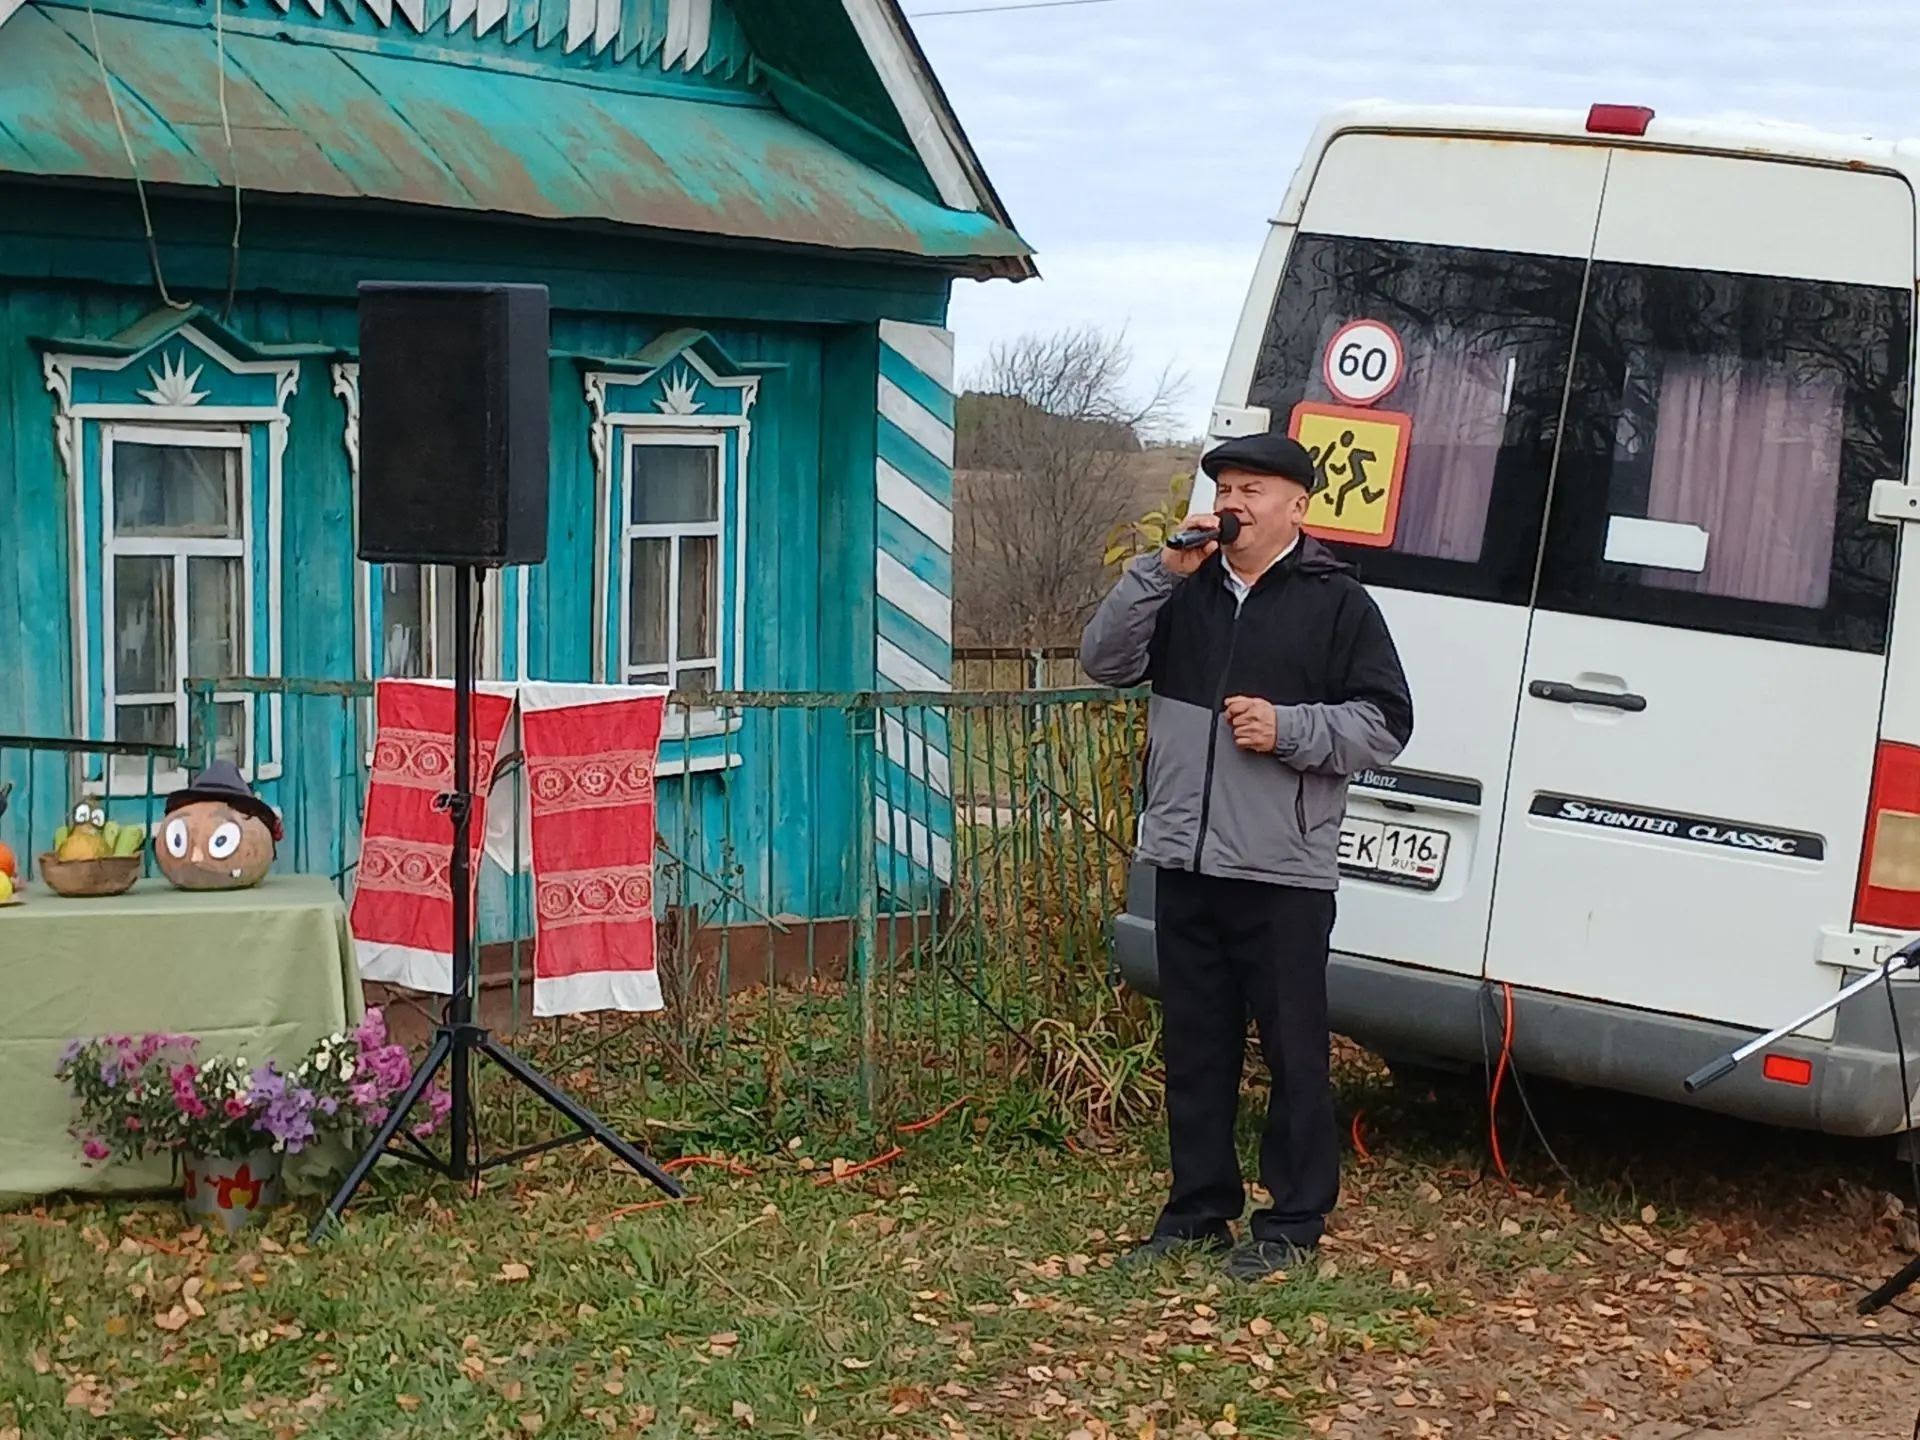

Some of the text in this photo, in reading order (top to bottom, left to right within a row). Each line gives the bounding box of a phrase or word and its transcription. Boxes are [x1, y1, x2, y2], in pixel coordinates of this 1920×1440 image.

[1339, 343, 1386, 381] 60
[1386, 830, 1432, 861] 116
[1688, 825, 1798, 853] CLASSIC
[1391, 858, 1417, 871] RUS
